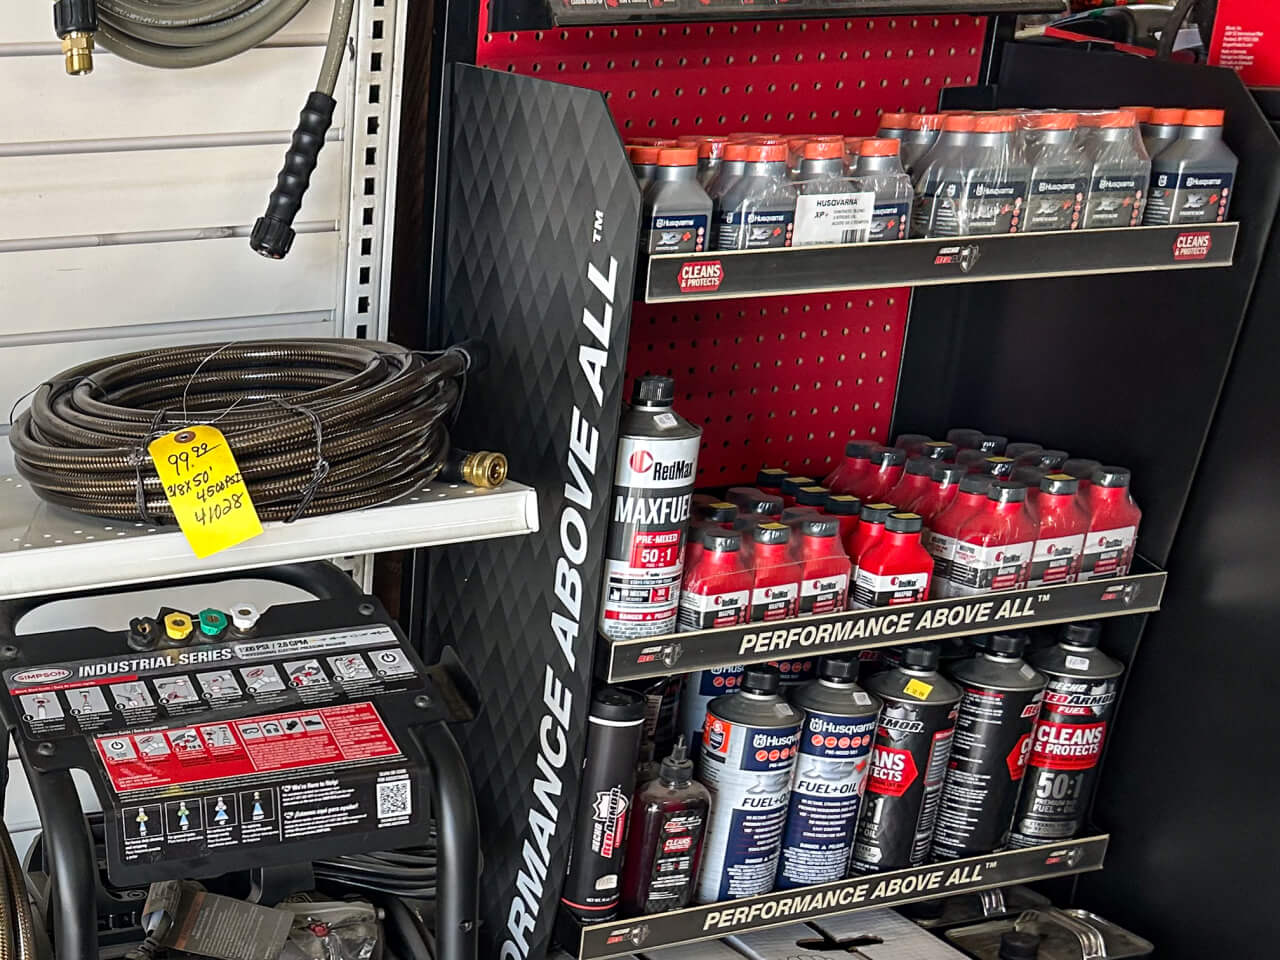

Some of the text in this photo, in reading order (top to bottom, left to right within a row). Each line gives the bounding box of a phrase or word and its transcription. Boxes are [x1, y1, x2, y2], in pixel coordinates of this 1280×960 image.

[1176, 235, 1209, 247] CLEANS
[1181, 246, 1207, 255] PROTECTS
[681, 265, 720, 278] CLEANS
[687, 277, 719, 286] PROTECTS
[653, 461, 693, 481] RedMax
[195, 492, 244, 525] 41028
[550, 405, 600, 672] ABOVE
[636, 533, 679, 544] PRE-MIXED
[739, 614, 915, 654] PERFORMANCE
[917, 605, 992, 629] ABOVE
[17, 670, 66, 681] SIMPSON
[79, 656, 174, 678] INDUSTRIAL
[179, 648, 232, 665] SERIES
[1057, 706, 1086, 714] FUEL
[1037, 726, 1104, 744] CLEANS
[1034, 743, 1098, 755] & PROTECTS
[797, 781, 857, 794] FUEL+OIL
[703, 886, 867, 931] PERFORMANCE
[869, 873, 942, 899] ABOVE
